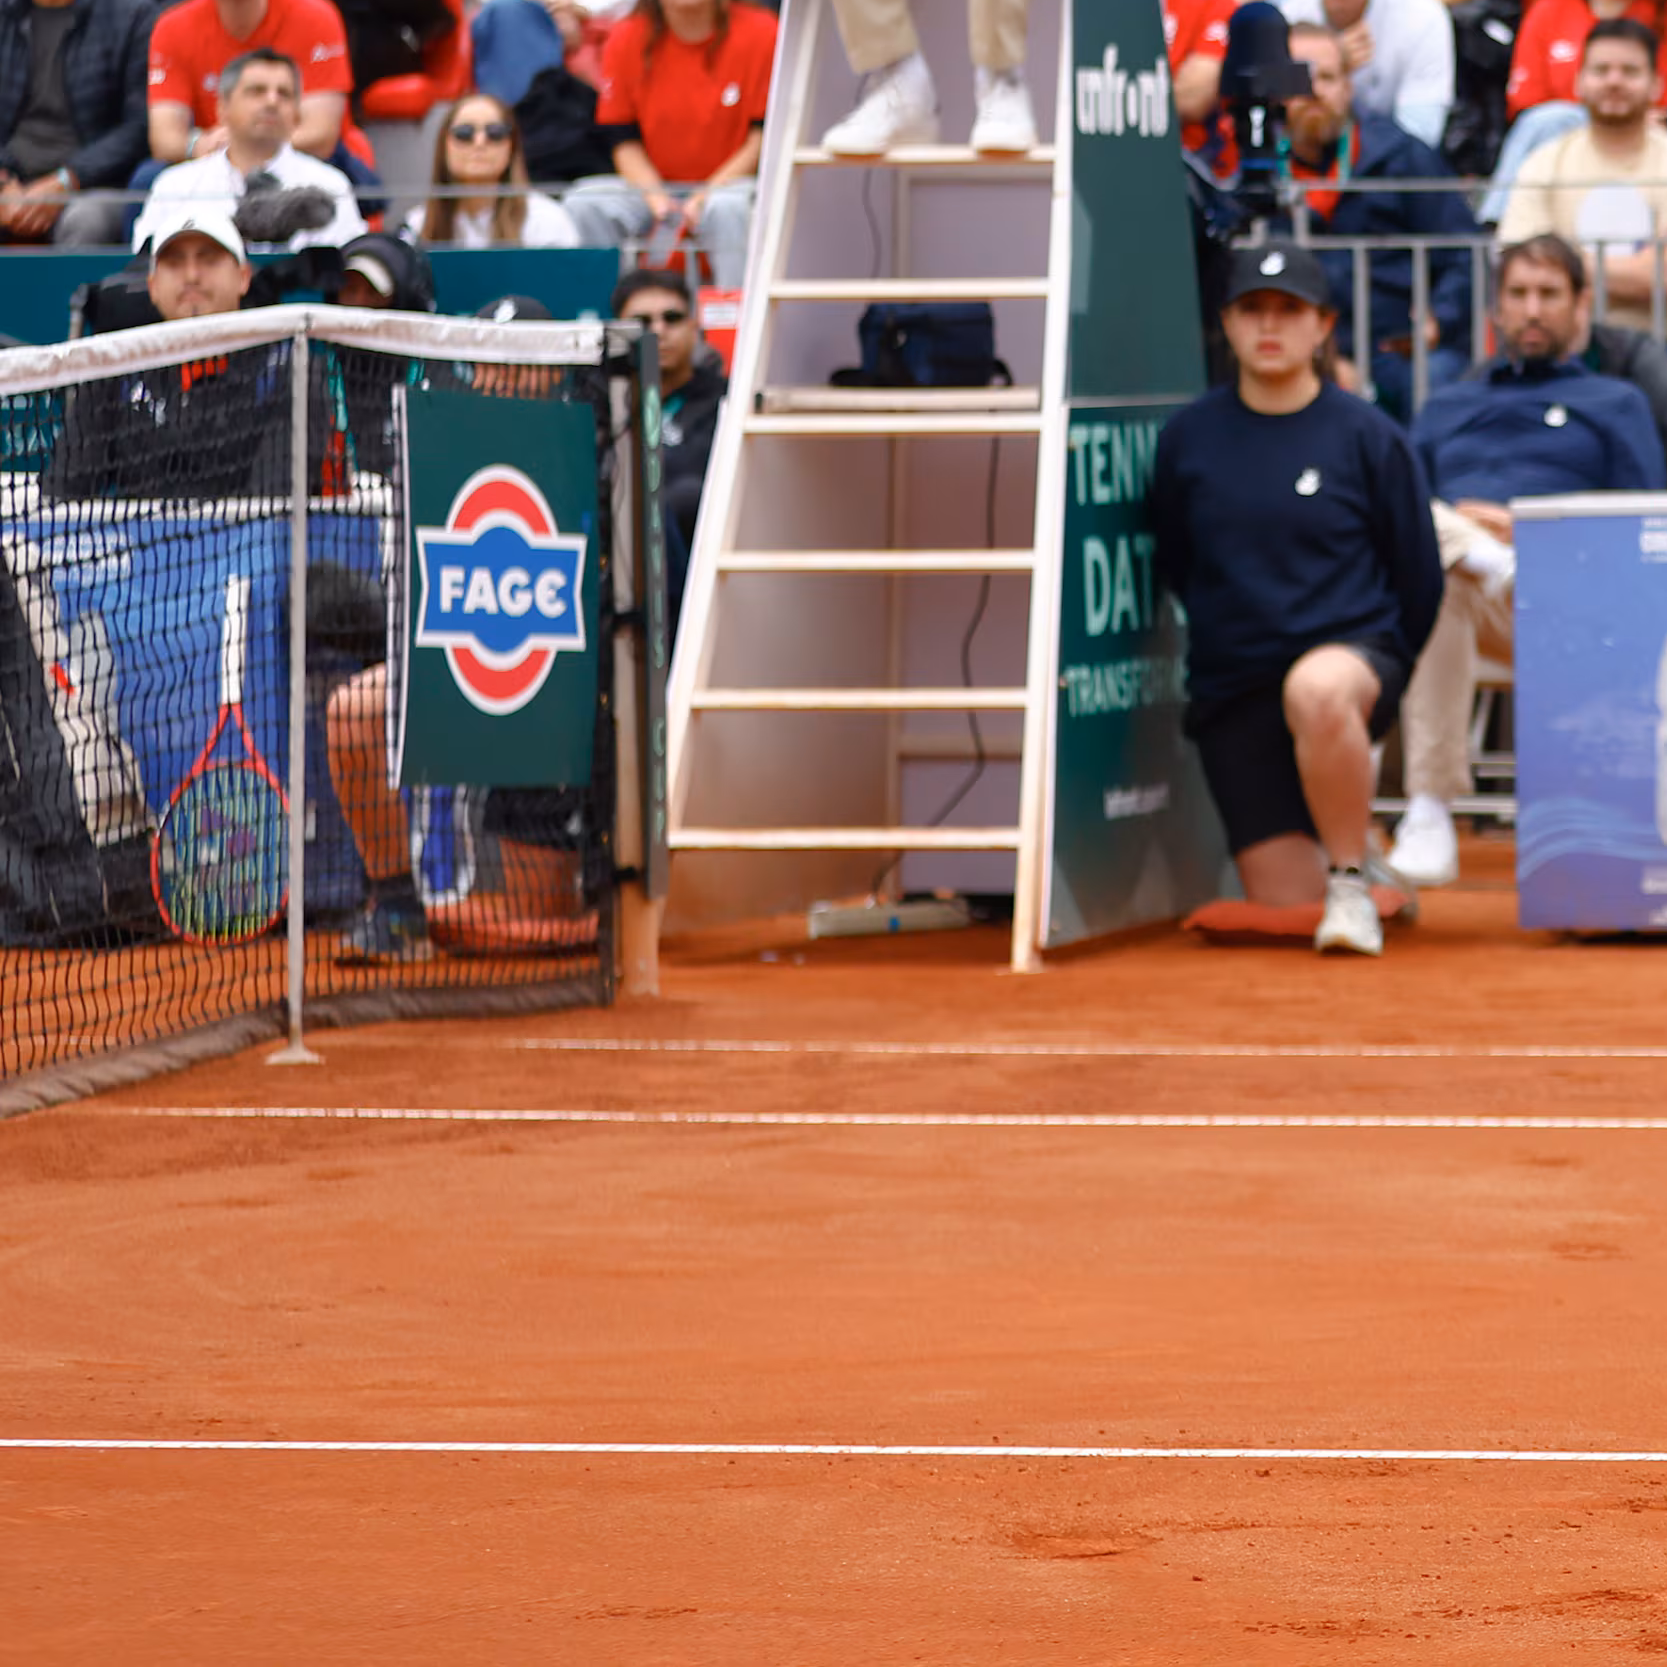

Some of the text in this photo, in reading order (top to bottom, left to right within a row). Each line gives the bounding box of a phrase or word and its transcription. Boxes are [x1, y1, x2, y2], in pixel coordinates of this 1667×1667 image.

[1069, 421, 1160, 506] TENN
[439, 564, 568, 619] FAGE
[1083, 535, 1187, 636] DAT
